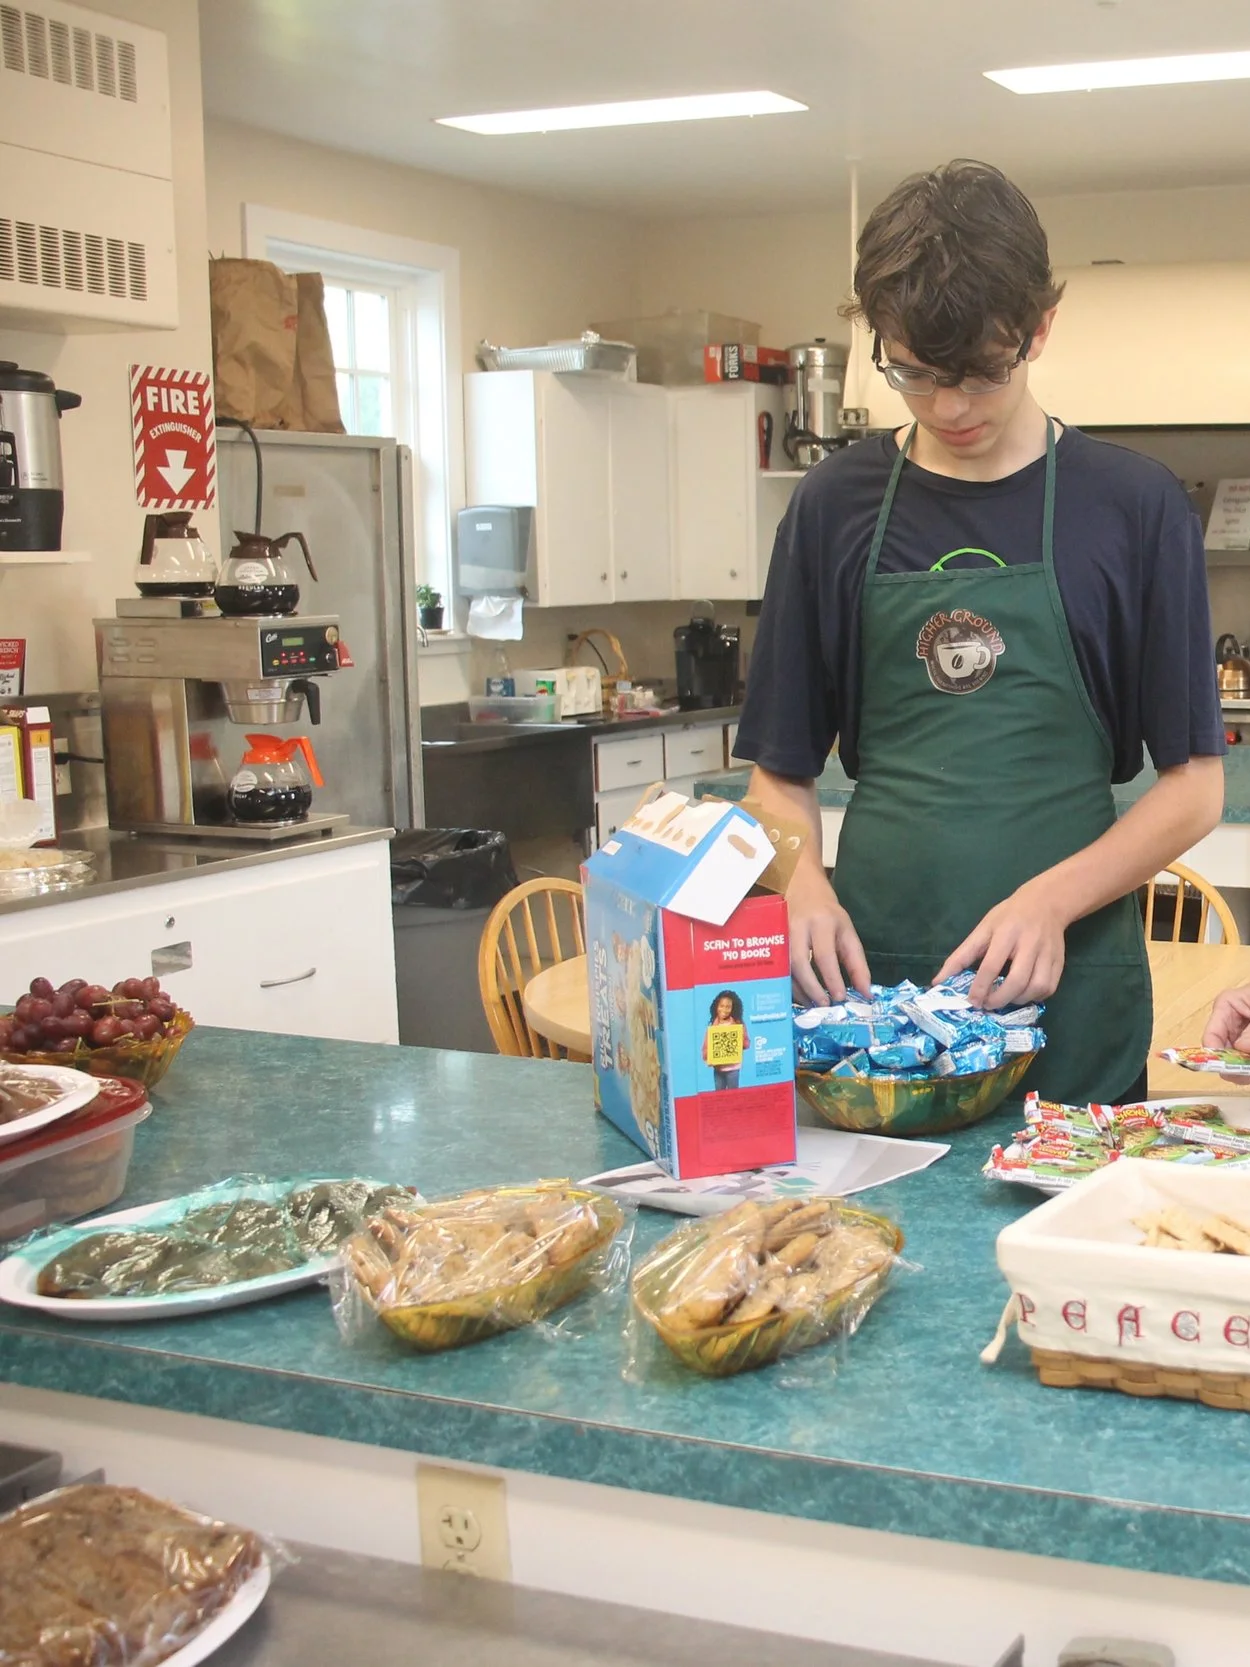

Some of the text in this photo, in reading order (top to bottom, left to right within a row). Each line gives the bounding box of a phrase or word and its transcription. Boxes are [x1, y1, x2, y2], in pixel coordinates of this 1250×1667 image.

[728, 345, 739, 379] FORKS
[146, 385, 200, 416] FIRE
[149, 421, 202, 443] EXTINGUISHER
[919, 610, 1003, 657] HIGHER GROUND
[703, 934, 785, 951] SCAN TO BROWSE
[722, 947, 771, 961] 140 BOOKS
[599, 946, 614, 1070] TREATS
